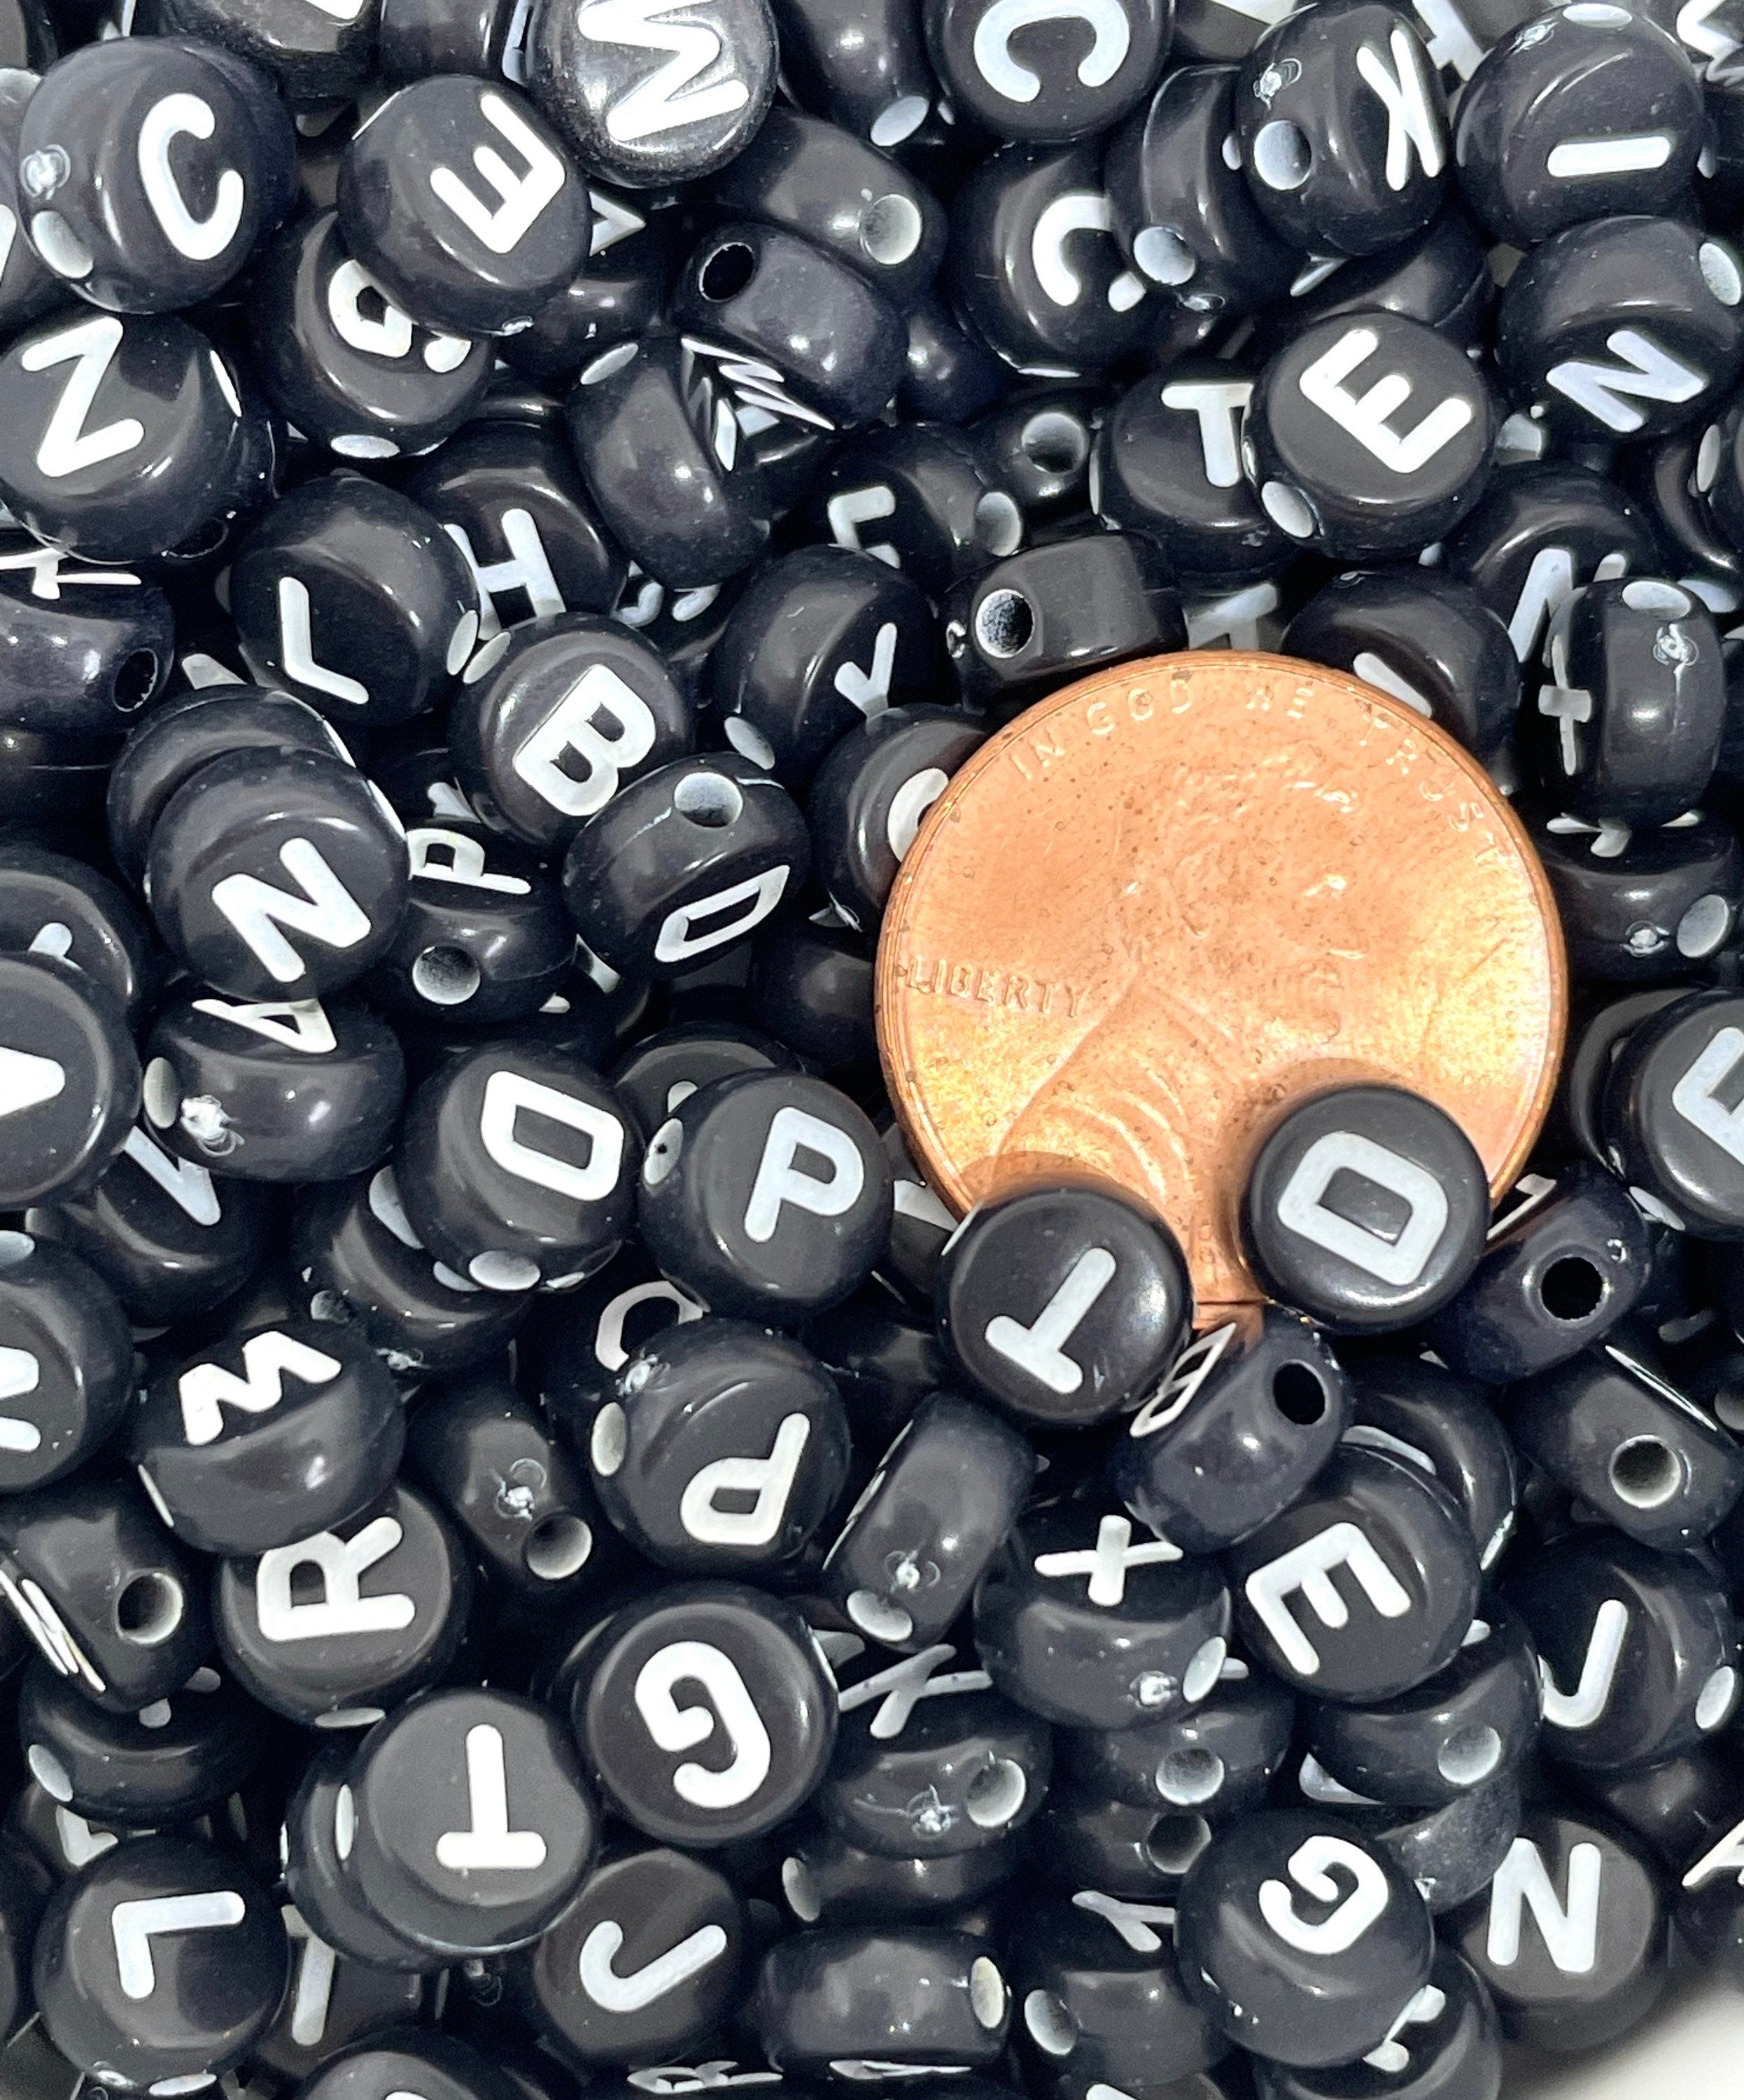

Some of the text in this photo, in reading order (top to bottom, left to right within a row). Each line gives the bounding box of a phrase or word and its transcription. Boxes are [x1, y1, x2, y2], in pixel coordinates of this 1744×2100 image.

[974, 0, 1130, 102] C
[1356, 25, 1440, 190] K
[139, 93, 243, 260] C
[430, 92, 565, 253] E
[1162, 383, 1253, 486] T
[1300, 328, 1472, 472] E
[444, 508, 566, 640] H
[279, 577, 368, 704] L
[512, 664, 655, 816] B
[1006, 735, 1067, 781] IN
[1085, 673, 1195, 737] GOD
[212, 838, 371, 981] N
[408, 828, 531, 894] P
[906, 954, 1089, 1018] LIBERTY
[745, 1107, 864, 1242] P
[1278, 1131, 1448, 1285] D
[985, 1248, 1116, 1394] T
[681, 1414, 809, 1545] P
[257, 1518, 414, 1642] R
[1035, 1516, 1183, 1606] X
[1246, 1523, 1411, 1674] E
[635, 1642, 770, 1808] G
[1538, 1600, 1628, 1728] J
[436, 1724, 547, 1870] T
[112, 1891, 245, 1999] L
[1259, 1836, 1388, 1954] G
[1488, 1838, 1601, 1974] N
[579, 1921, 726, 2012] J
